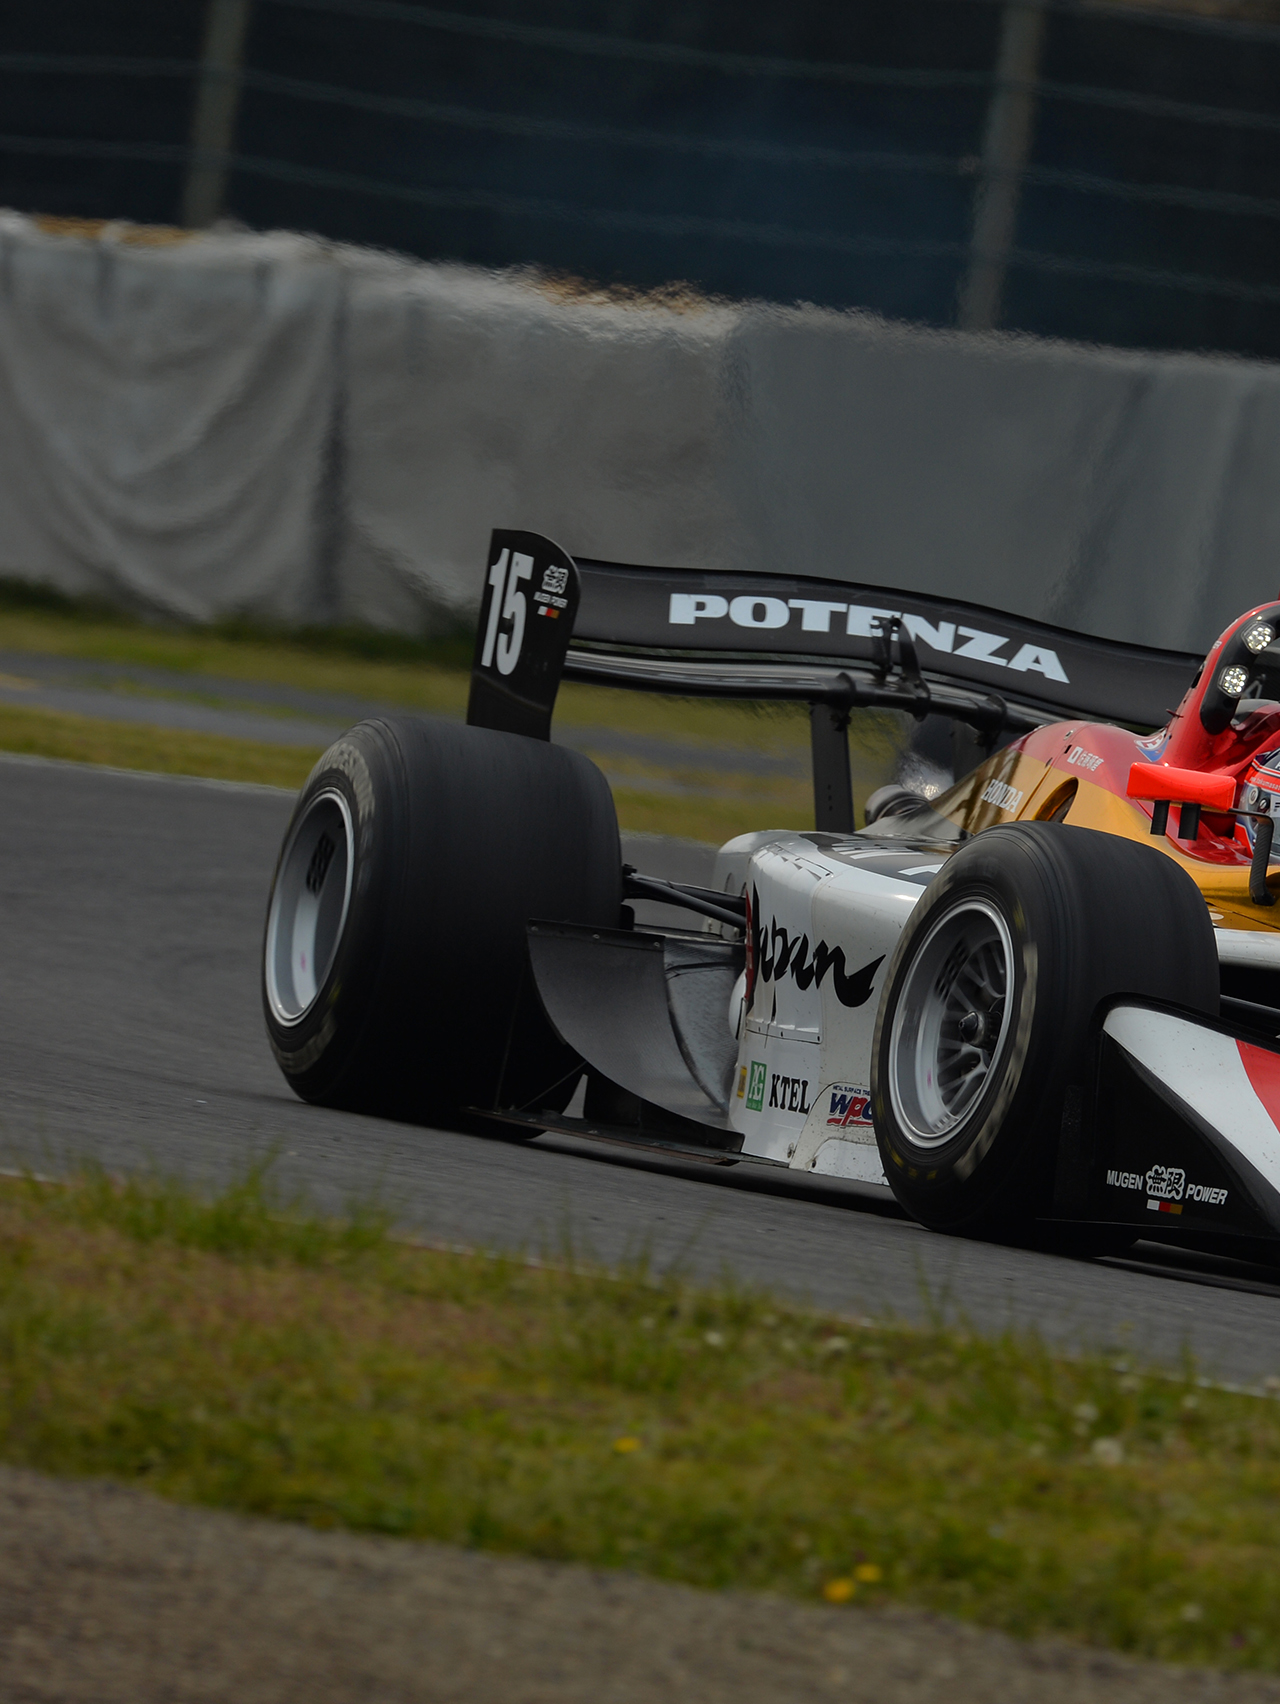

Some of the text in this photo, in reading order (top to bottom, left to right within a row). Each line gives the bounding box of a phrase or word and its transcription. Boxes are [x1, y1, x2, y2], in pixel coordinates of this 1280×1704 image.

[481, 548, 534, 675] 15
[669, 593, 1070, 684] POTENZA
[980, 778, 1024, 813] HONDA
[768, 1073, 810, 1115] KTEL
[1106, 1169, 1144, 1190] MUGEN
[1185, 1183, 1228, 1205] POWER
